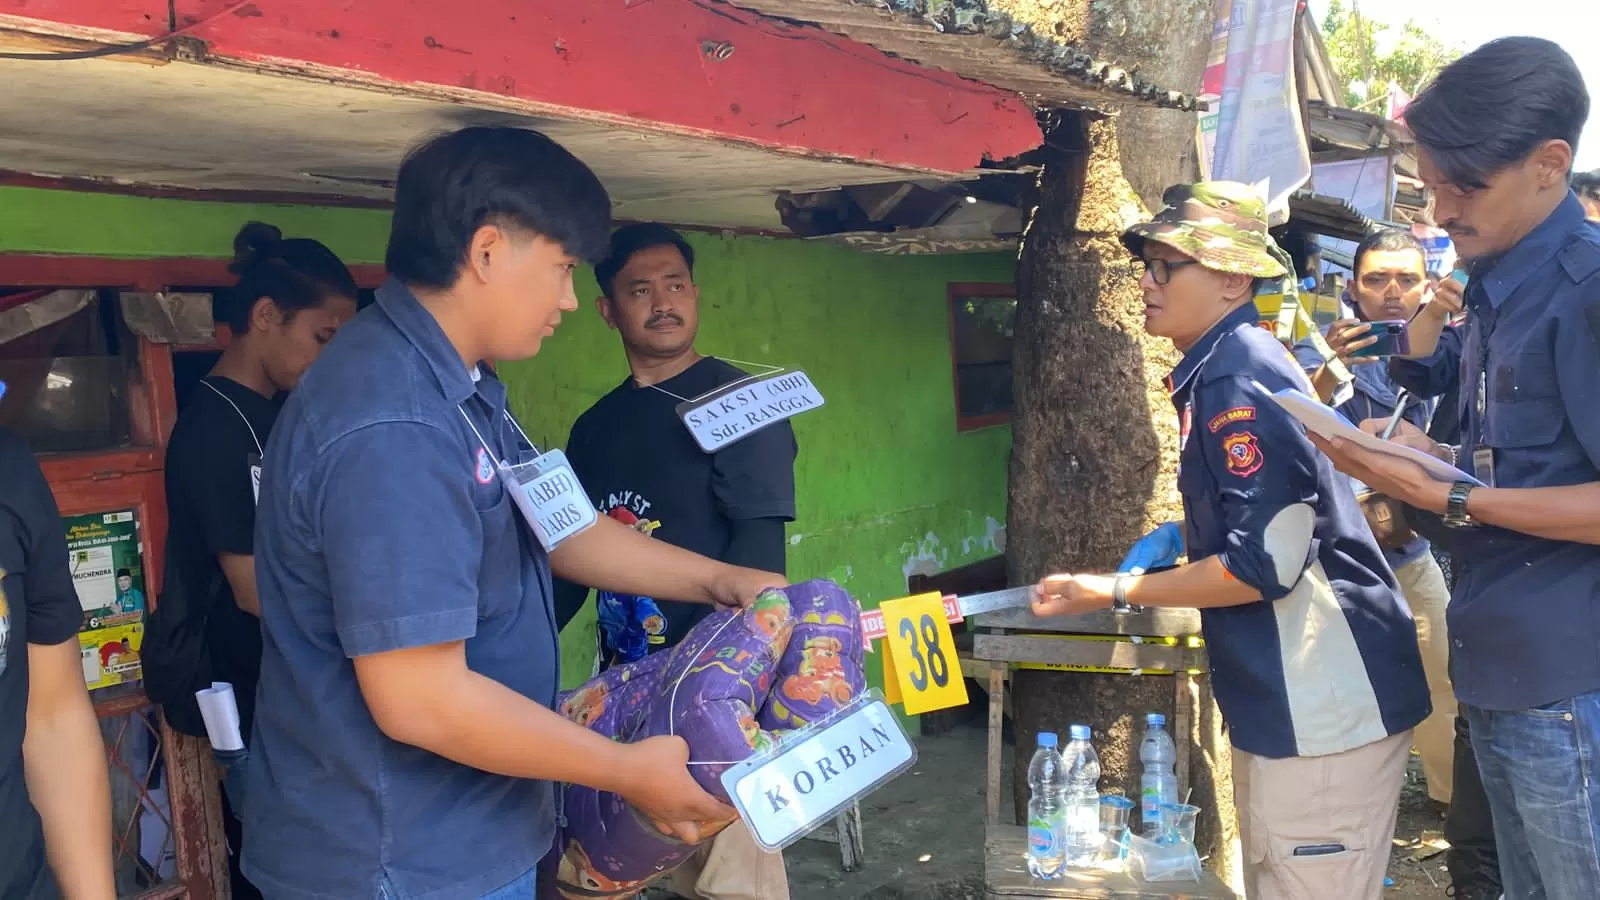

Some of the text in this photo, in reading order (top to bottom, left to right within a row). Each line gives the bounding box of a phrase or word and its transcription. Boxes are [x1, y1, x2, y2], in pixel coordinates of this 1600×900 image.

[688, 374, 809, 428] SAKSI (ABH)
[711, 394, 814, 442] Sdr. RANGGA
[1227, 410, 1252, 419] BARAT
[527, 472, 574, 510] (ABH)
[899, 613, 949, 692] 38
[763, 724, 892, 814] KORBAN
